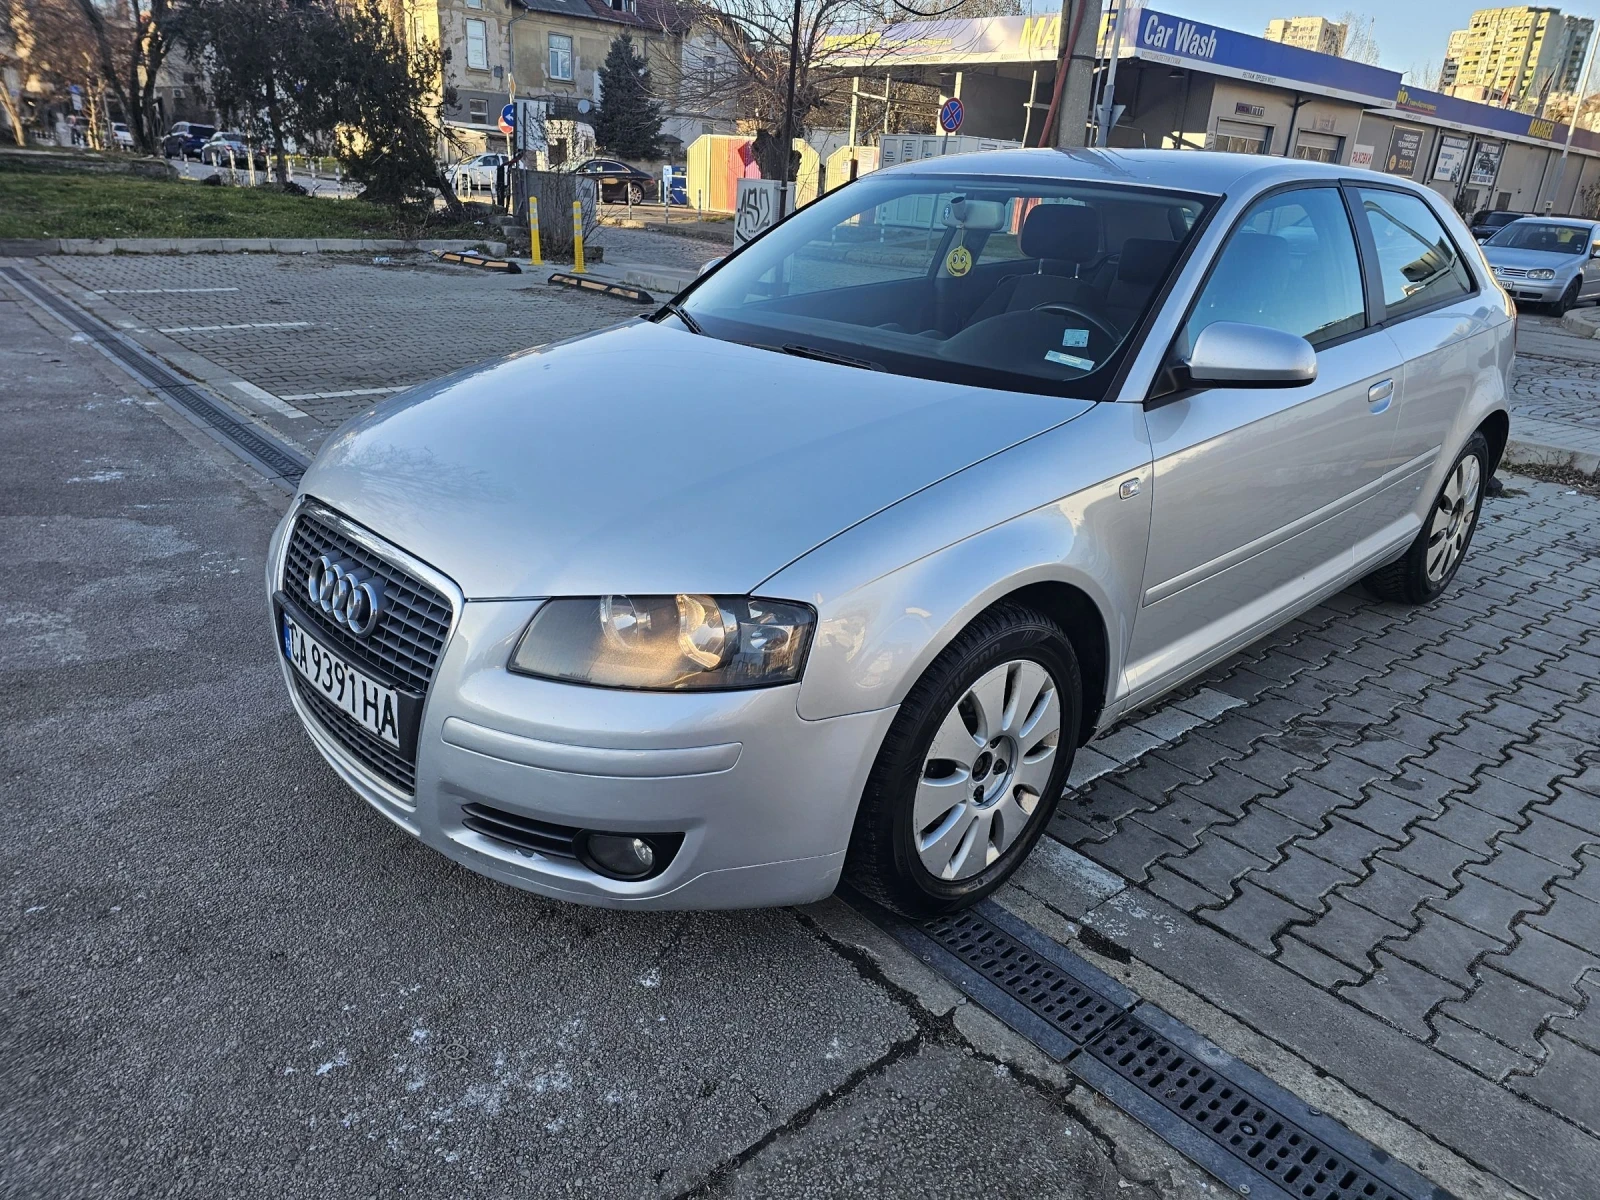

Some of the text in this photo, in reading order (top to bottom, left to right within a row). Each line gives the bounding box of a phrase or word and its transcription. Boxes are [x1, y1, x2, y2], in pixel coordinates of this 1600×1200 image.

[1144, 14, 1217, 59] Car Wash
[289, 622, 398, 740] CA 9391 HA
